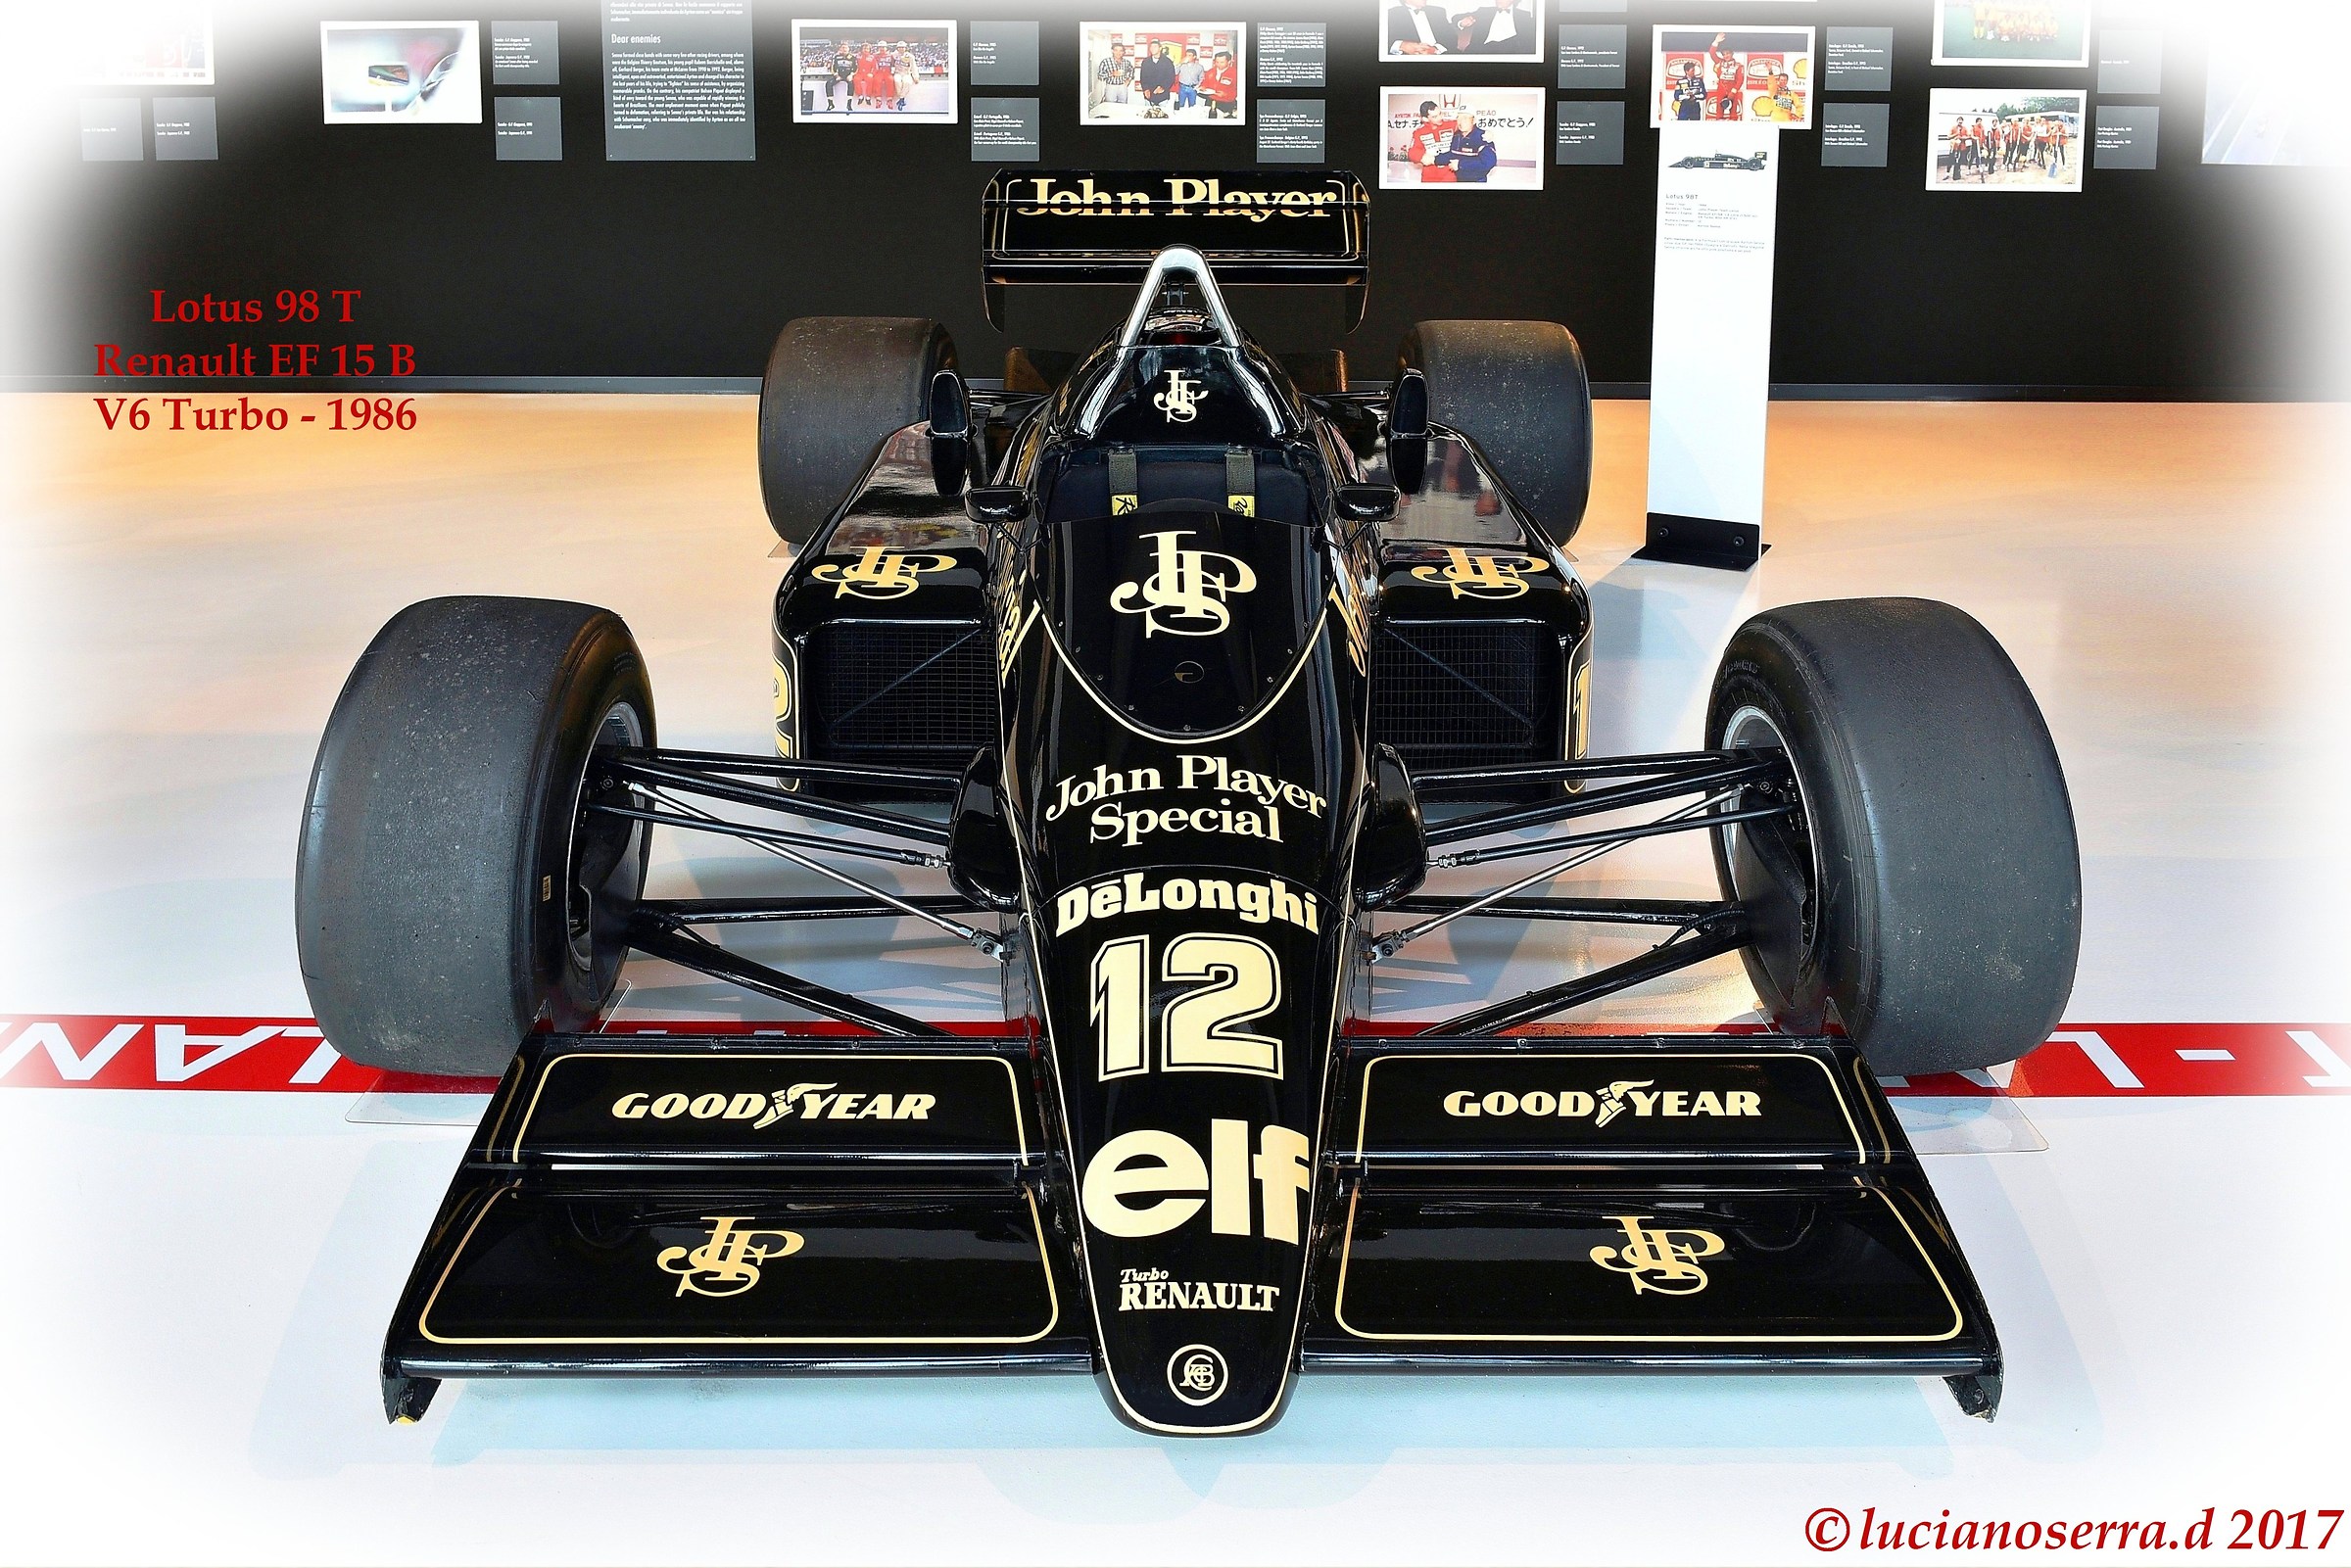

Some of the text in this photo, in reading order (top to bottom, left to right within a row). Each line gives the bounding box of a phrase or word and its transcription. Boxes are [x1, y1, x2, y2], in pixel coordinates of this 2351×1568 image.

[611, 33, 661, 44] Dear enemies
[1017, 178, 1337, 222] John Player
[1045, 755, 1327, 822] John Player
[1090, 798, 1284, 847] Special
[1090, 932, 1284, 1082] 12
[1081, 1117, 1310, 1246] elf
[1119, 1281, 1280, 1312] RENAULT
[1120, 1267, 1170, 1284] Turbo
